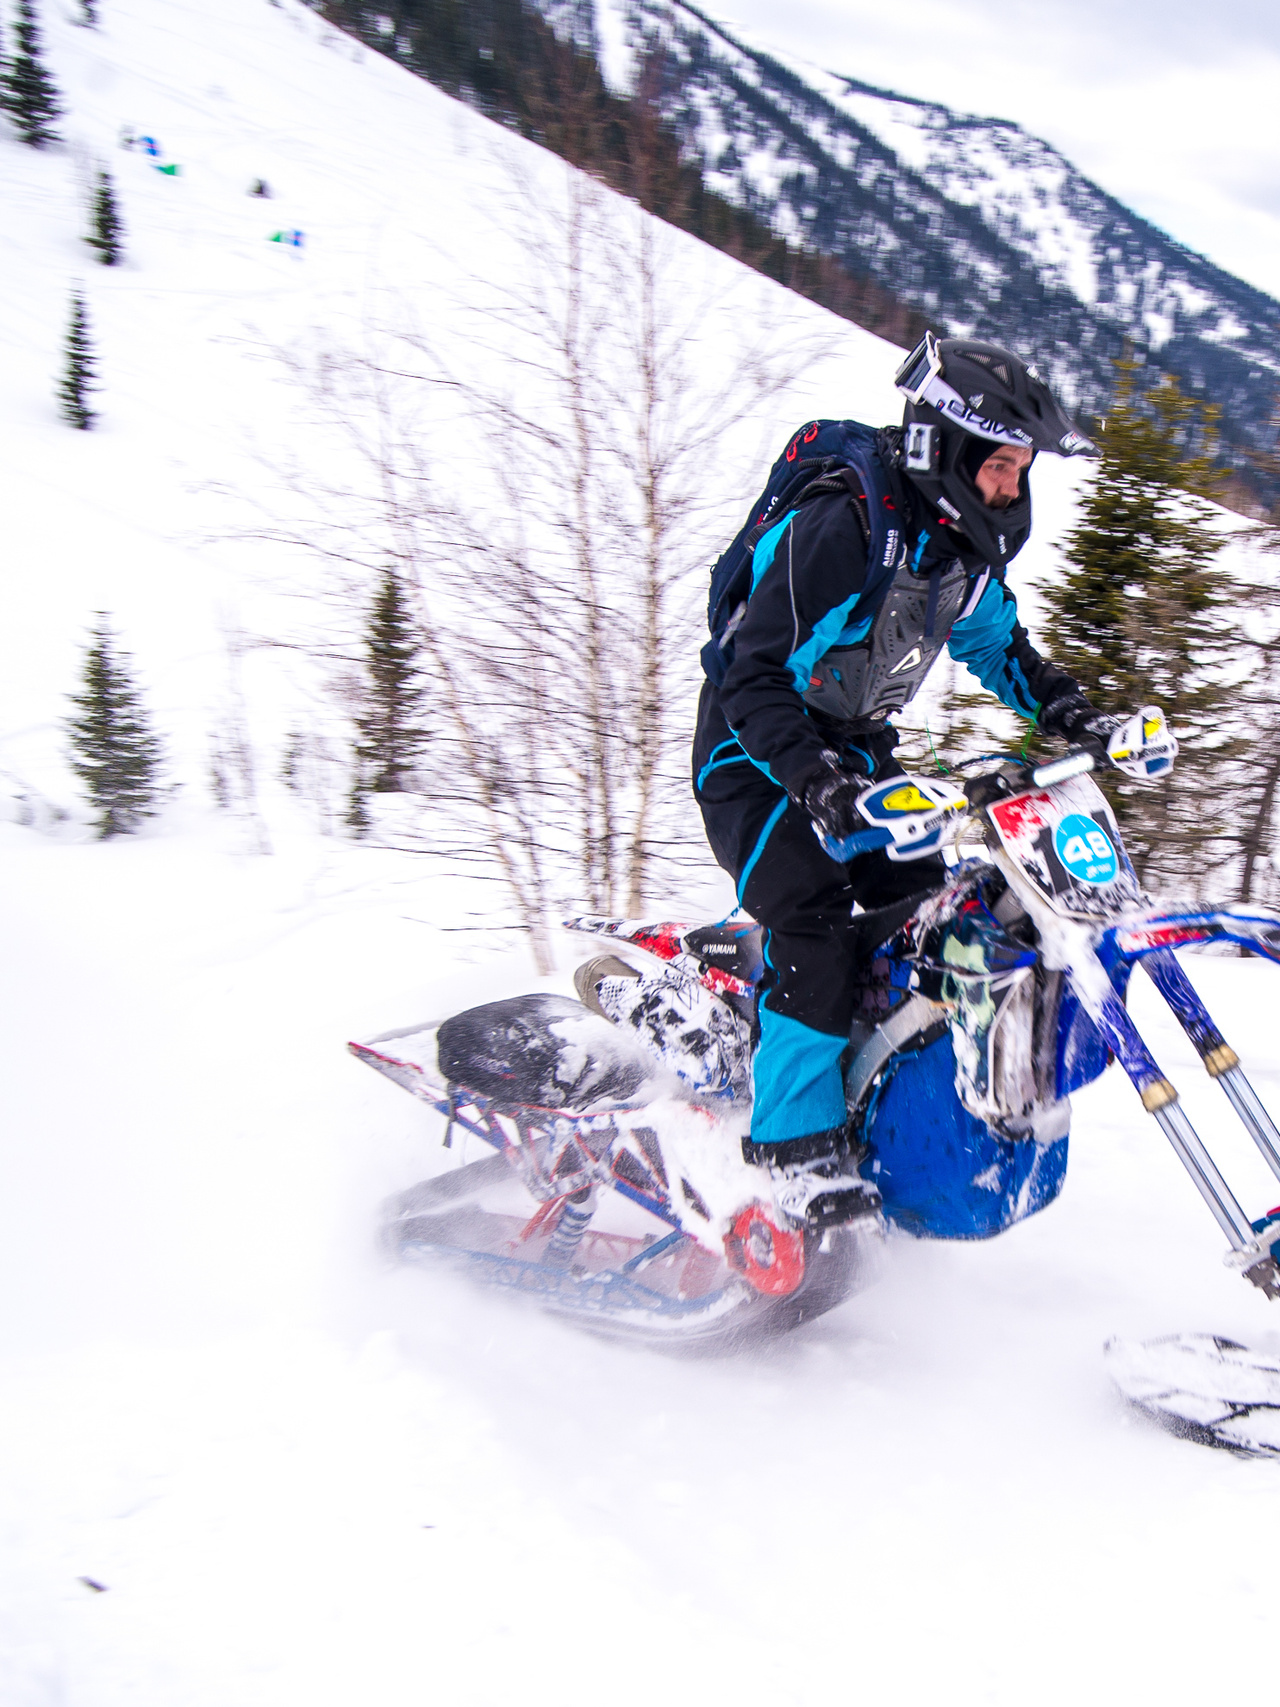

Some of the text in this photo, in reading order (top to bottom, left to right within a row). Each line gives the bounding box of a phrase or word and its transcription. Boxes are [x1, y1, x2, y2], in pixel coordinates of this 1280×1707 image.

[882, 529, 895, 568] AIRBAG
[1062, 830, 1113, 864] 48
[708, 943, 737, 955] YAMAHA
